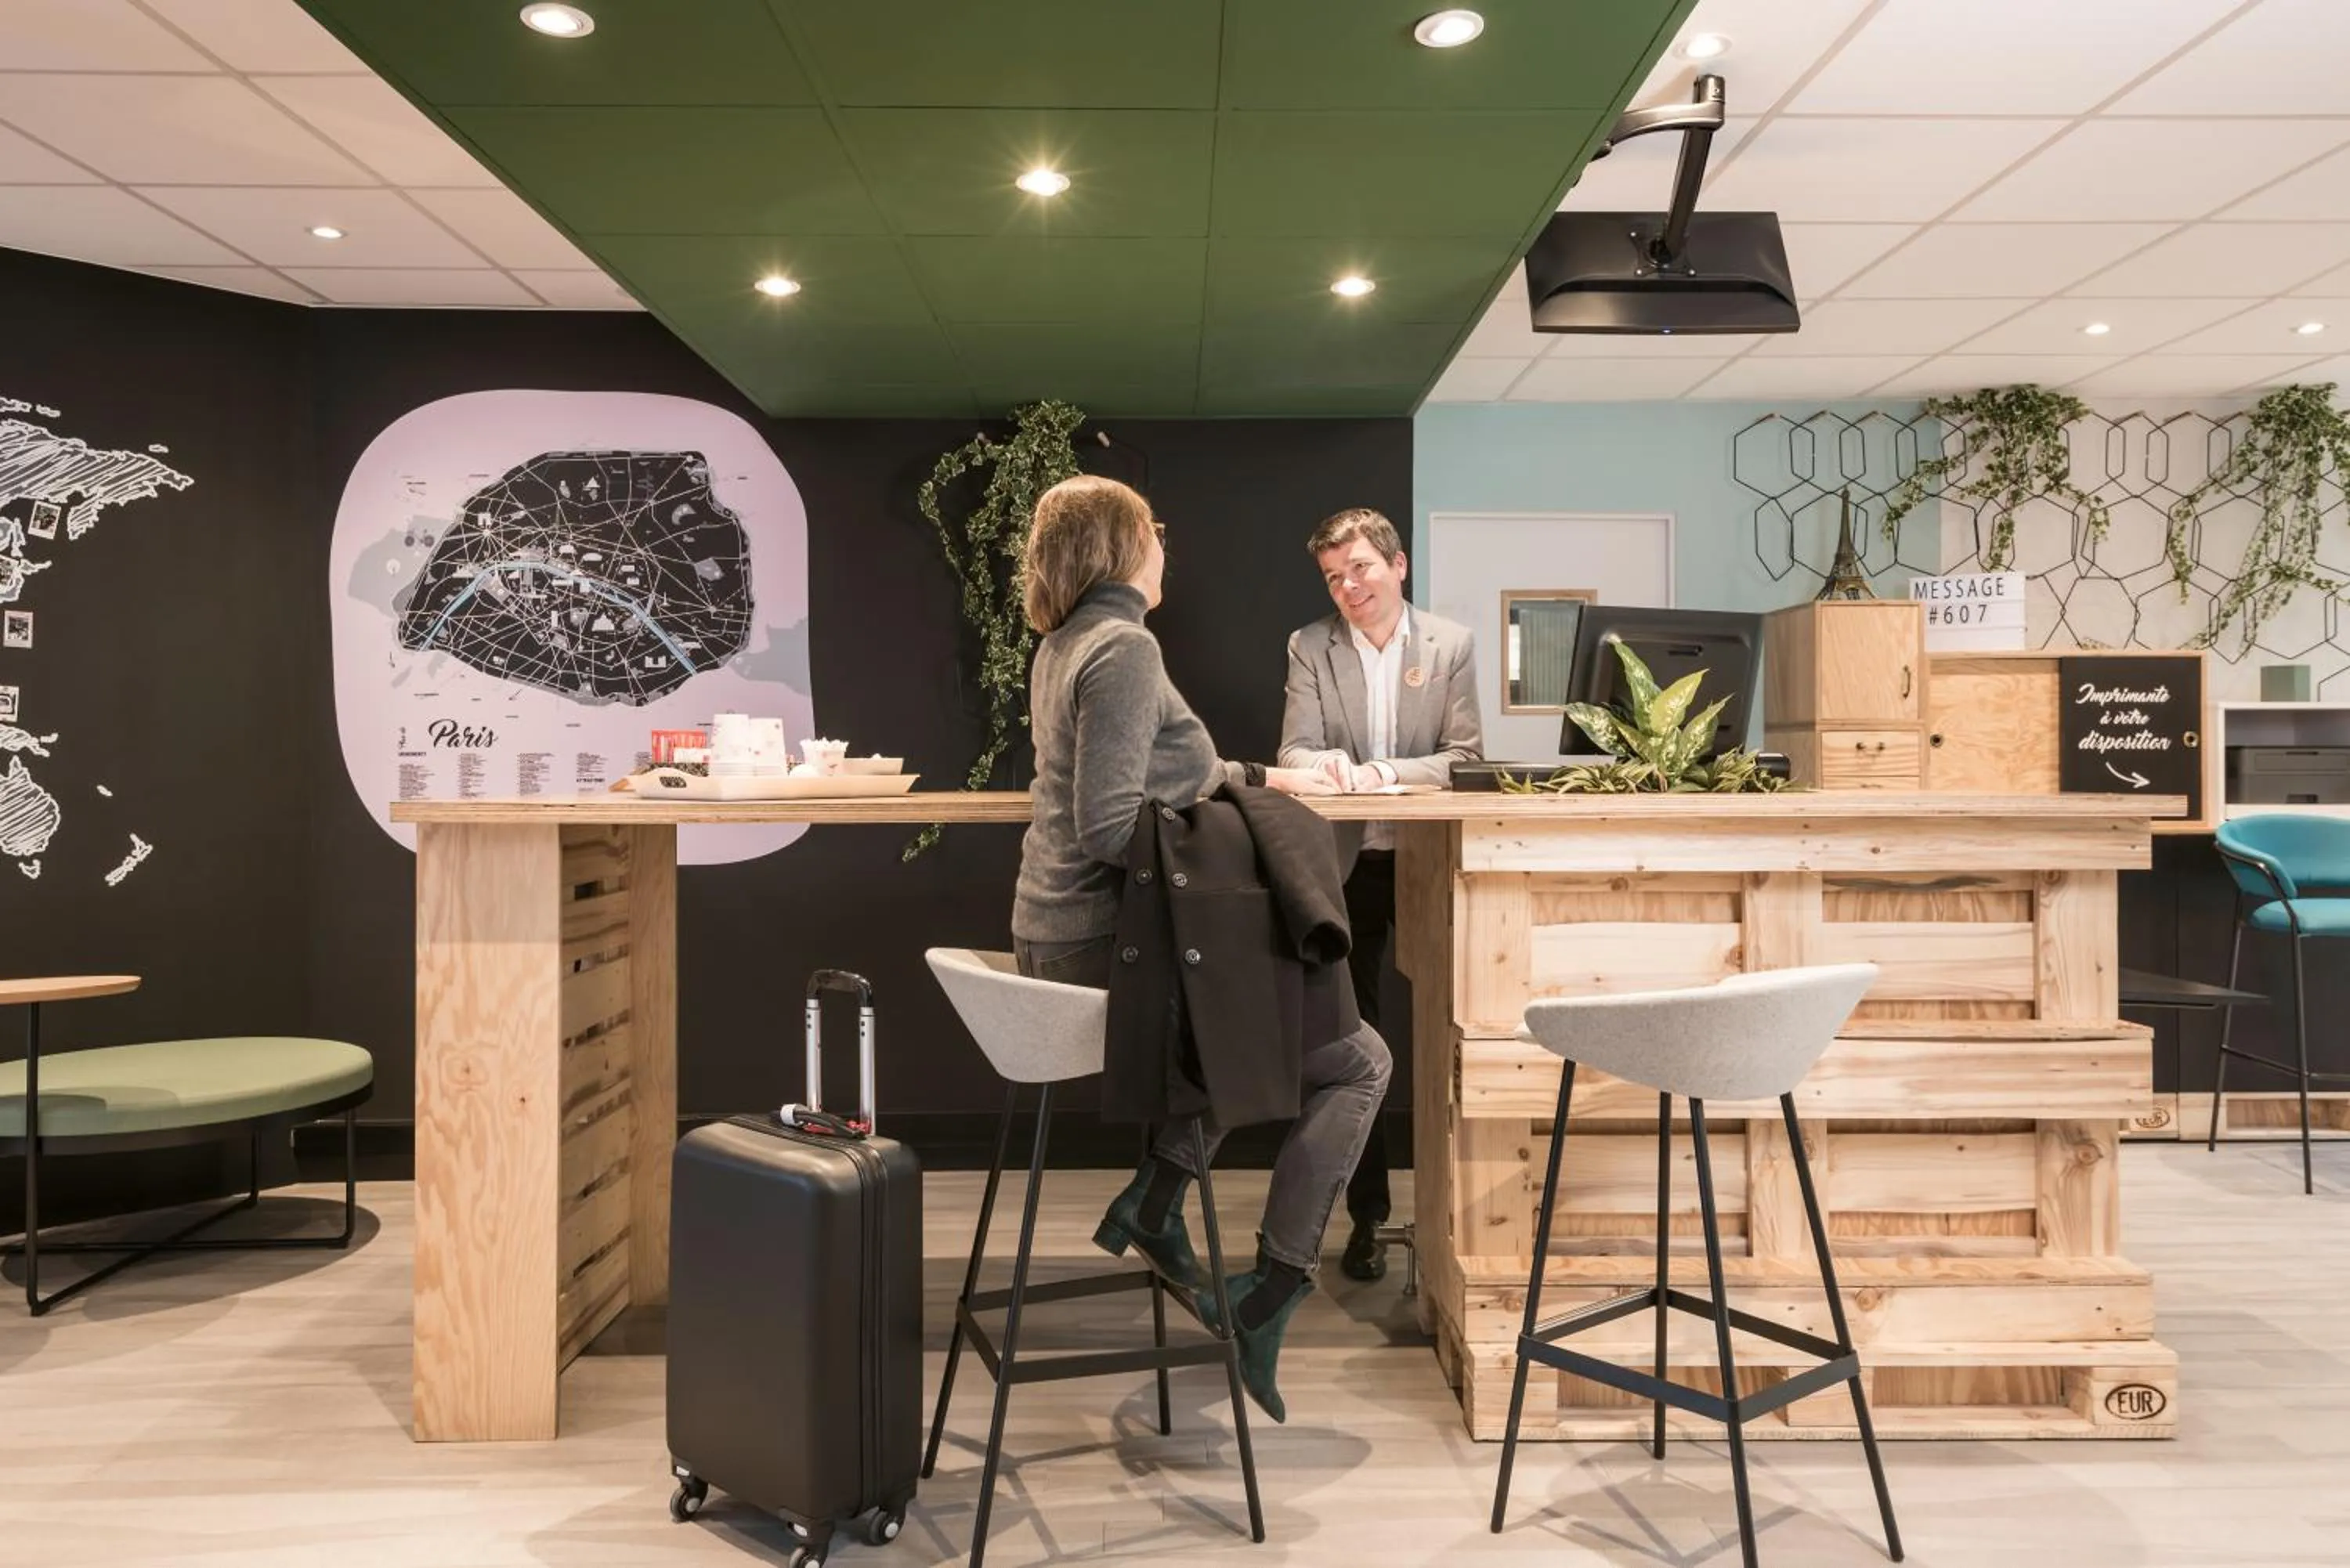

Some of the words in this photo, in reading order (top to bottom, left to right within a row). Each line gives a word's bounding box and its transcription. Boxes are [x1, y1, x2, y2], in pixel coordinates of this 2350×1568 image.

[1914, 577, 2005, 599] MESSAGE
[1929, 604, 1987, 625] #607
[2076, 683, 2170, 706] Imprimante
[2113, 708, 2150, 724] votre
[428, 718, 498, 748] Paris
[2078, 729, 2171, 754] disposition
[2117, 1390, 2153, 1414] EUR
